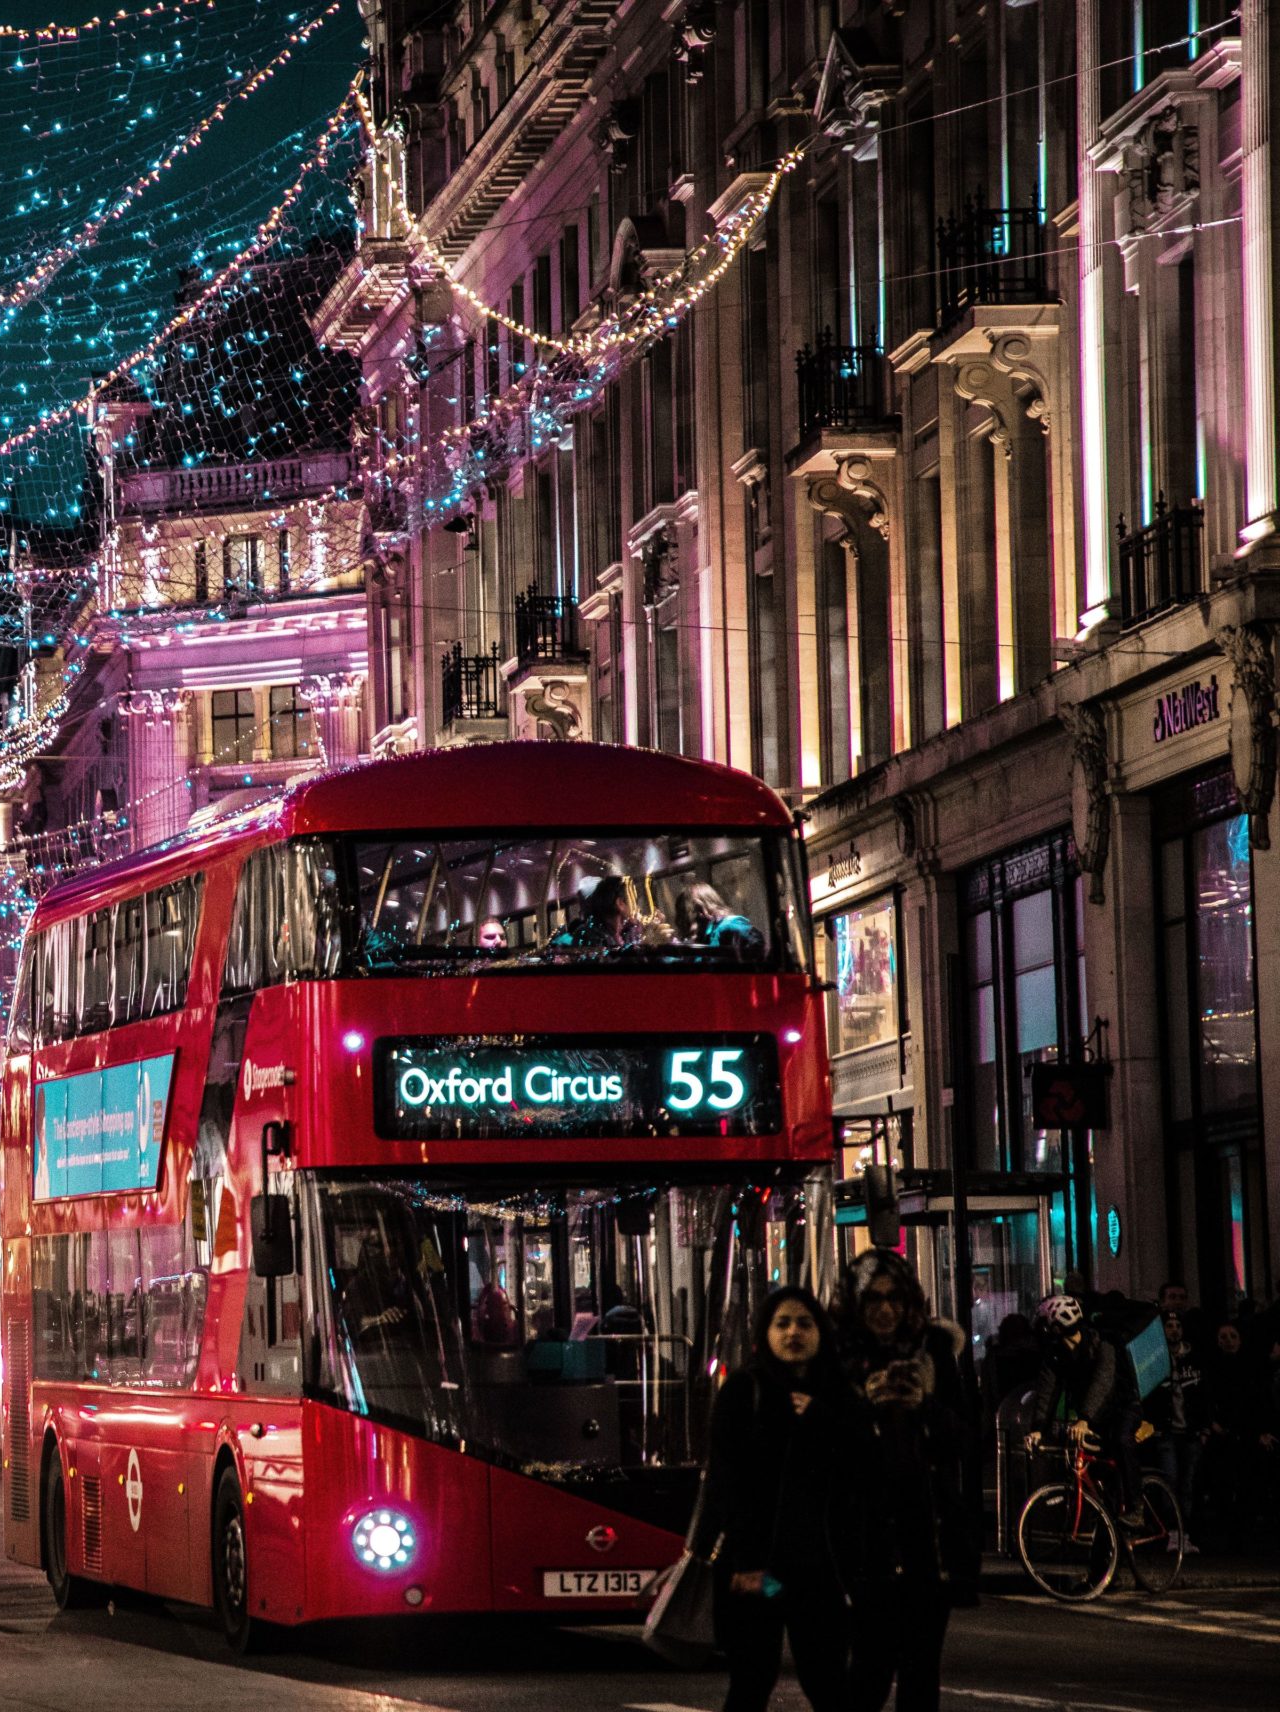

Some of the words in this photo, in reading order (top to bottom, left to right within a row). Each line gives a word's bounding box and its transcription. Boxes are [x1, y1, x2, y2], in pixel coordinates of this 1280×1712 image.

[1161, 674, 1220, 738] NatWest
[400, 1066, 512, 1104] Oxford
[524, 1065, 623, 1103] Circus
[668, 1050, 745, 1111] 55
[559, 1572, 598, 1593] LTZ
[604, 1572, 641, 1592] 1313
